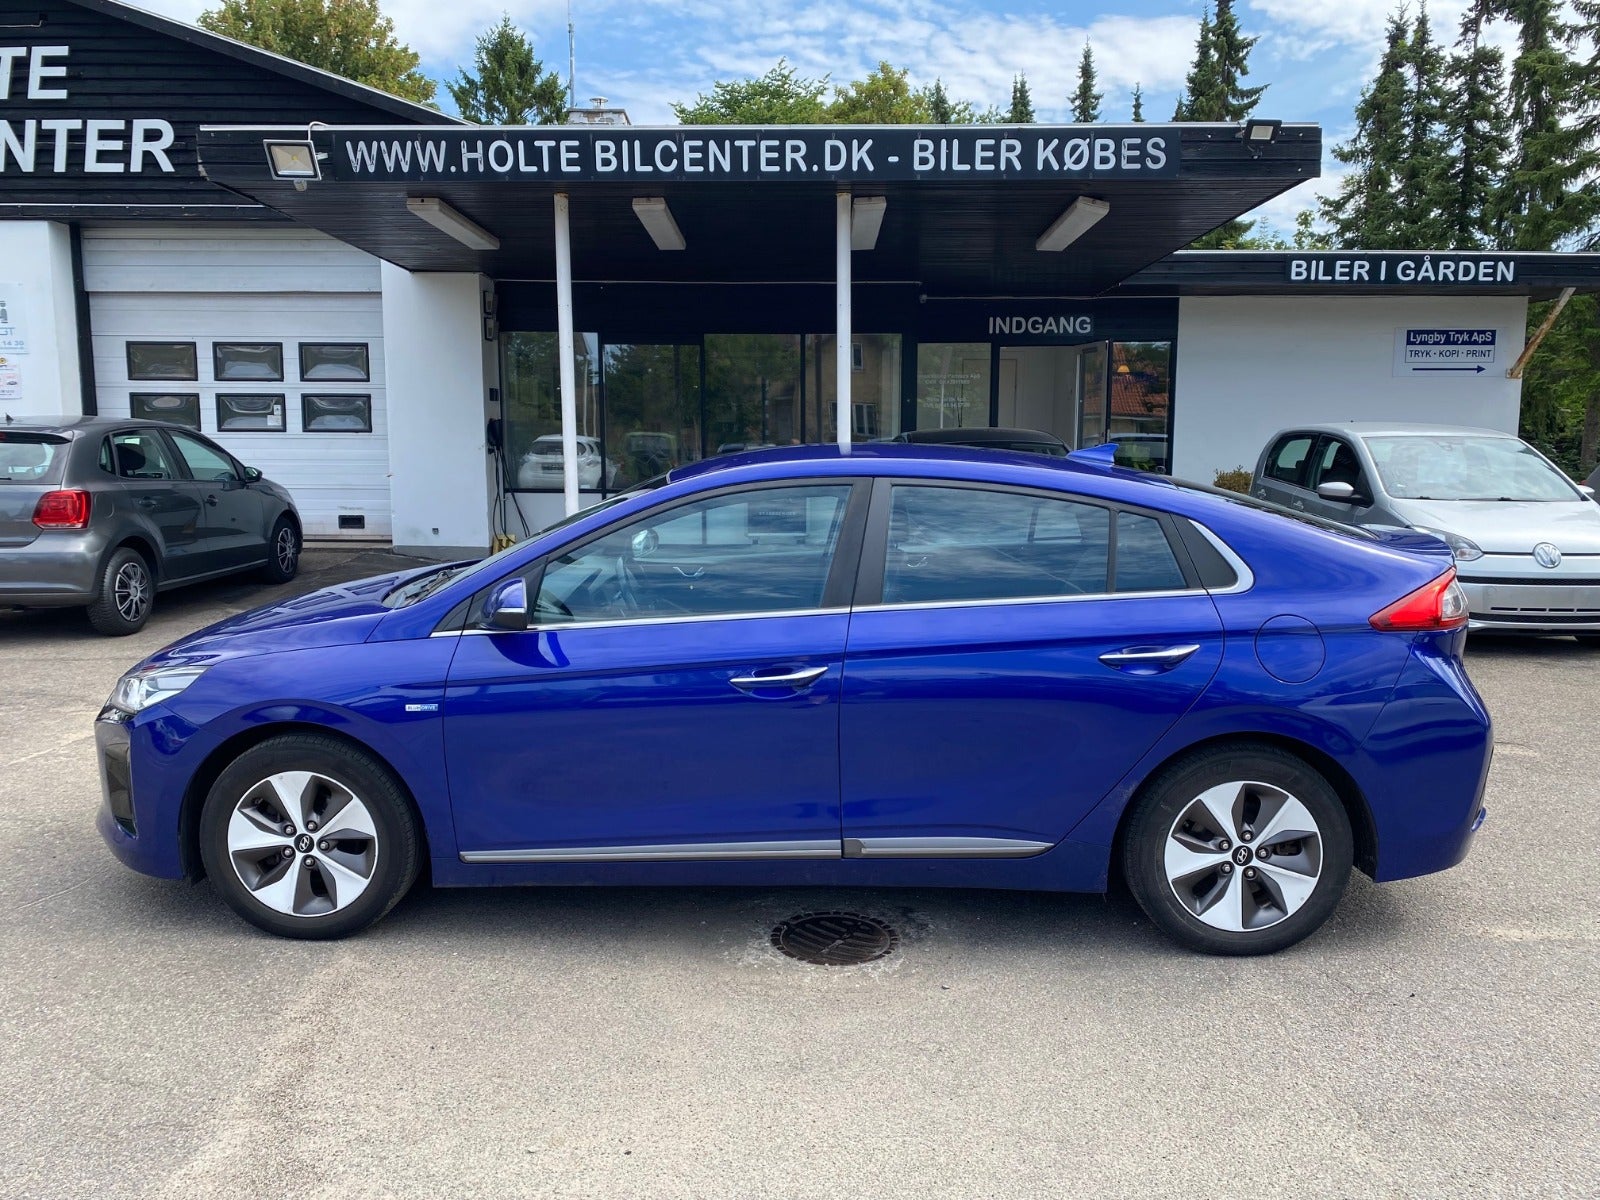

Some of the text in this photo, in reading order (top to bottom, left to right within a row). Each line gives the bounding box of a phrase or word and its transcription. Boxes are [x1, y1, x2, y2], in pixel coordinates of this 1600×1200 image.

[0, 46, 70, 100] TE
[0, 118, 176, 173] NTER
[345, 138, 582, 173] WWW.HOLTE
[595, 138, 875, 173] BILCENTER.DK
[913, 138, 1022, 172] BILER
[1037, 137, 1167, 171] KØBES
[1290, 255, 1515, 282] BILER I GÅRDEN
[988, 316, 1091, 334] INDGANG
[1410, 331, 1492, 344] Lyngby Tryk ApS
[1409, 349, 1492, 358] TRYK KOPI PRINT
